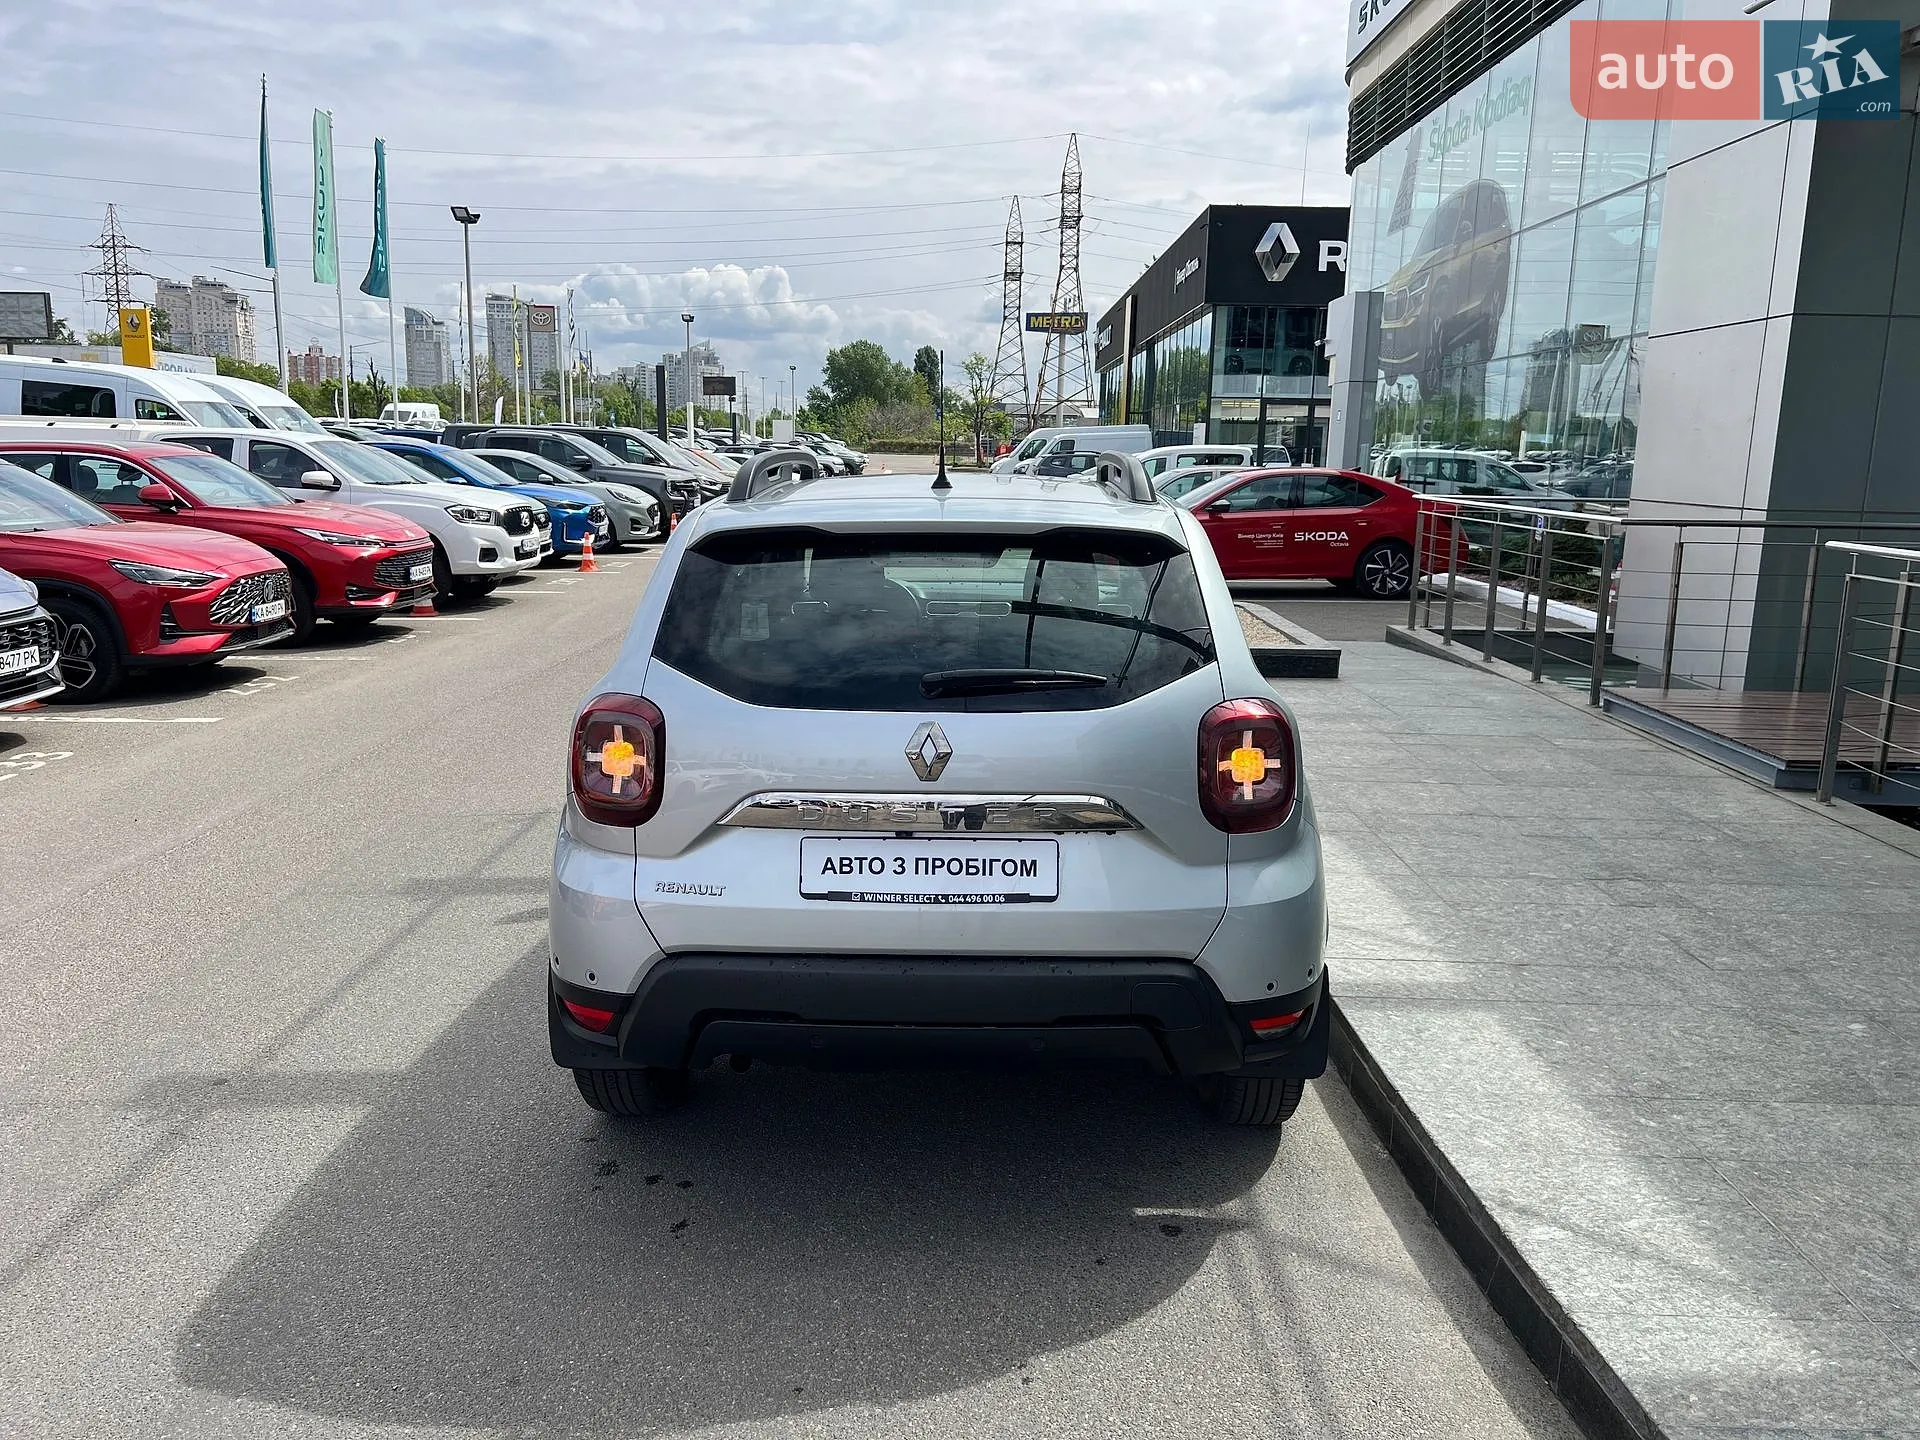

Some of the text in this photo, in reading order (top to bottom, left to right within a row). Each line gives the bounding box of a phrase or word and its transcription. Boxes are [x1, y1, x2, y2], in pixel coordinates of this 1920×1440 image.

[1358, 0, 1391, 34] SK
[1472, 75, 1532, 136] Kodiaq
[1030, 315, 1084, 328] METRO
[797, 805, 1059, 825] DUSTER
[821, 856, 886, 875] АВТО
[914, 857, 1038, 877] ПРОБІГОМ
[655, 881, 727, 897] RENAULT
[863, 892, 902, 903] WINNER
[903, 894, 936, 904] SELECT
[948, 894, 965, 903] 044
[965, 894, 982, 903] 496
